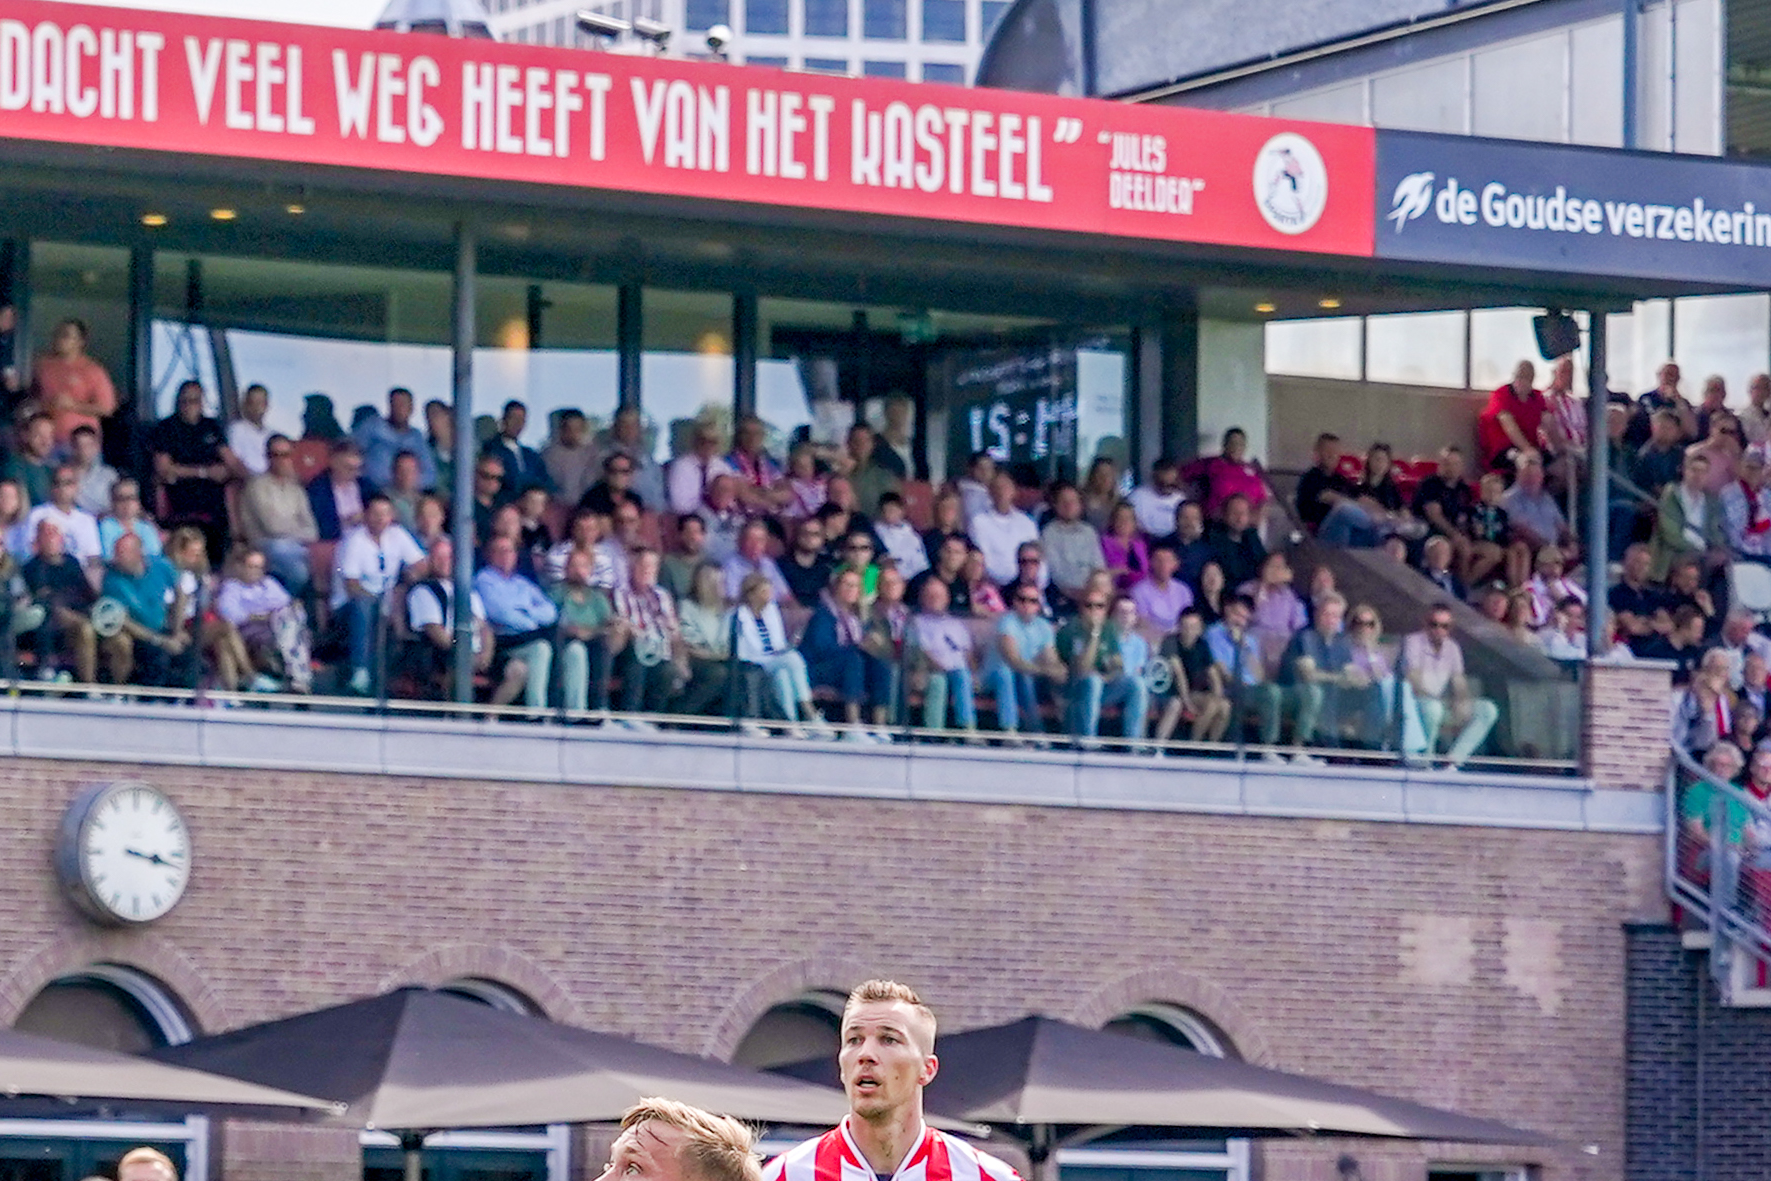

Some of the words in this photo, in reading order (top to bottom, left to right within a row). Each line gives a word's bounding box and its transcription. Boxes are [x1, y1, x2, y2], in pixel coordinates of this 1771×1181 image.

[183, 35, 316, 136] VEEL
[332, 48, 445, 147] WEG
[461, 61, 612, 162] HEEFT
[630, 76, 730, 173] VAN
[746, 88, 835, 182] HET
[1435, 176, 1478, 226] de
[1481, 181, 1604, 234] Goudse
